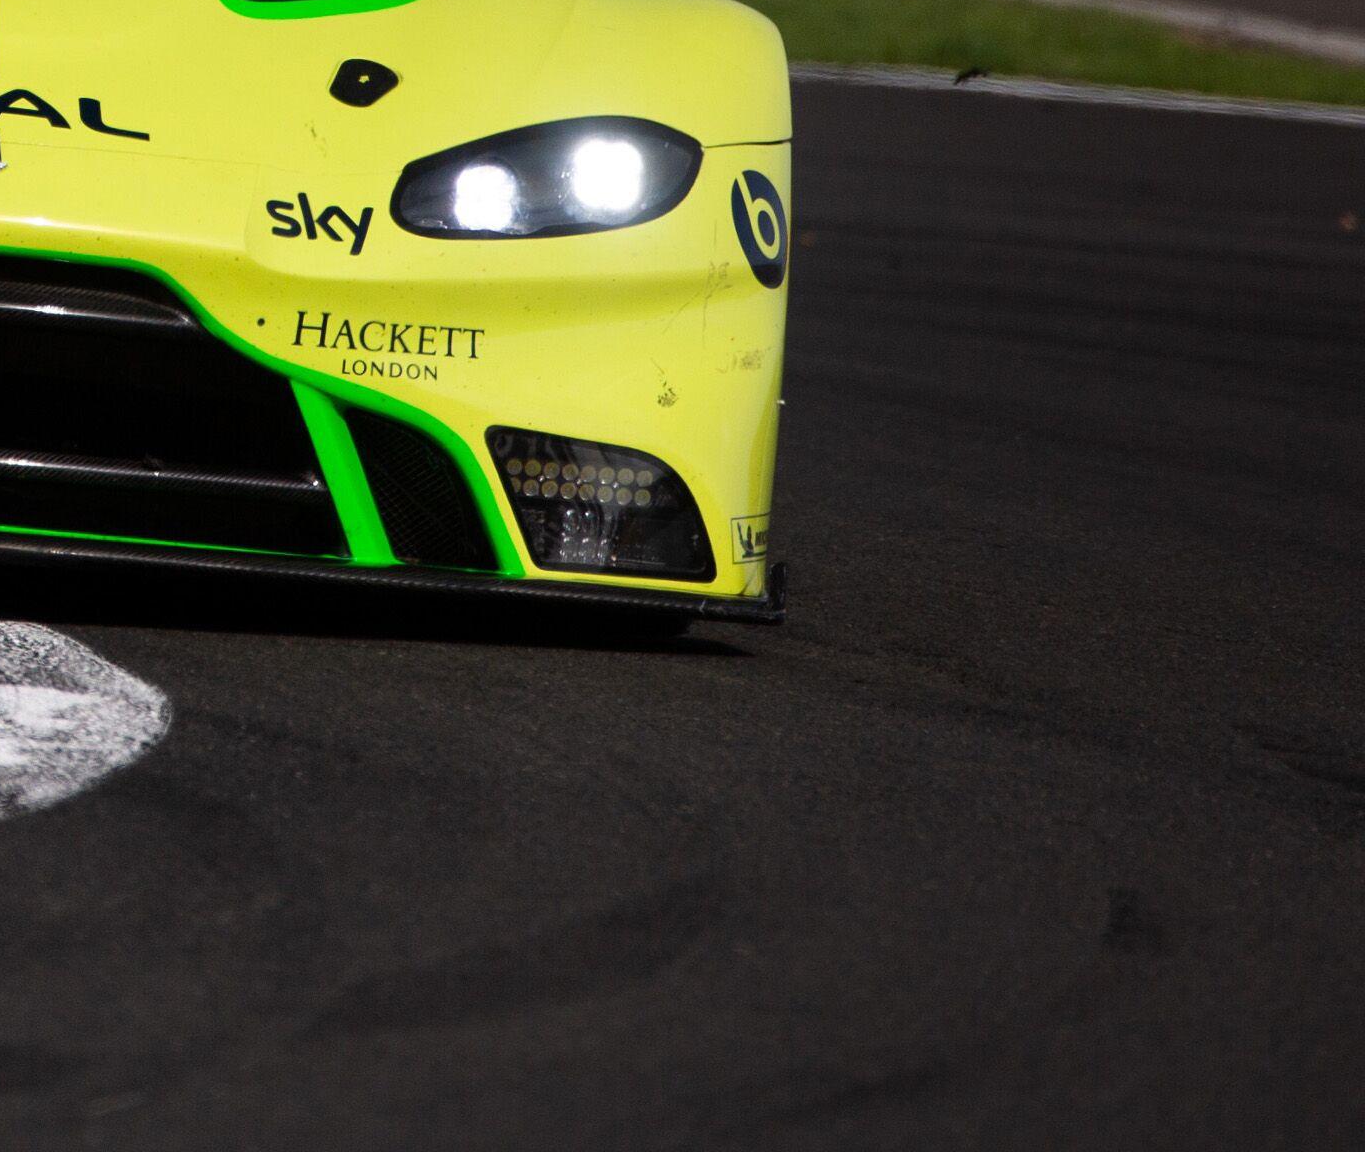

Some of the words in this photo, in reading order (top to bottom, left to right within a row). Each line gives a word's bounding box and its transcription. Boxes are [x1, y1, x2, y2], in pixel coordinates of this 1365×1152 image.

[265, 192, 374, 256] sky
[291, 310, 485, 360] HACKETT
[341, 358, 439, 381] LONDON
